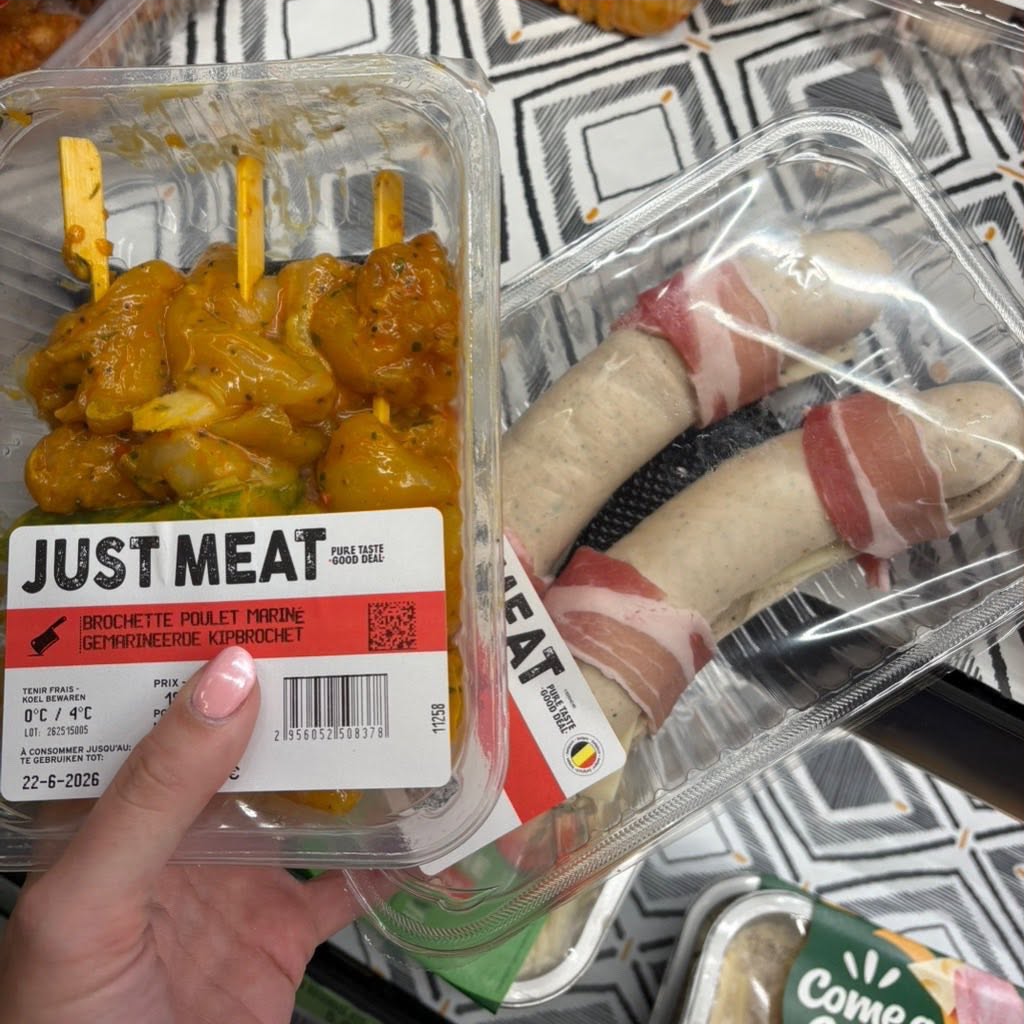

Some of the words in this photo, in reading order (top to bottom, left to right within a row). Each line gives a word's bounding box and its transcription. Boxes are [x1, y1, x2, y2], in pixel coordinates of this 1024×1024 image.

[331, 545, 356, 556] PURE
[358, 543, 385, 555] TASTE
[22, 535, 160, 594] JUST
[174, 527, 327, 587] MEAT
[332, 555, 359, 565] GOOD
[361, 553, 384, 564] DEAL
[82, 612, 173, 631] BROCHETTE
[181, 609, 239, 627] POULET
[247, 606, 305, 625] MARINÉ
[82, 630, 201, 651] GEMARINEERDE
[209, 627, 304, 646] KIPBROCHET
[22, 687, 47, 695] TENIR
[49, 686, 74, 694] FRAIS
[153, 678, 179, 688] PRIX
[22, 695, 44, 704] KOEL
[45, 694, 86, 703] BEWAREN
[24, 707, 47, 723] 0°C
[55, 707, 62, 721] /
[69, 706, 92, 720] 4°C
[546, 684, 563, 707] PURE
[558, 705, 577, 730] TASTE
[431, 703, 445, 735] 11258
[24, 728, 41, 738] LOT:
[20, 747, 26, 757] À
[29, 746, 84, 756] CONSOMMER
[86, 744, 132, 754] JUSQU'AU:
[33, 755, 84, 764] GEBRUIKEN
[86, 754, 104, 762] TOT:
[22, 772, 100, 790] 22-6-2026
[797, 968, 906, 1024] Come
